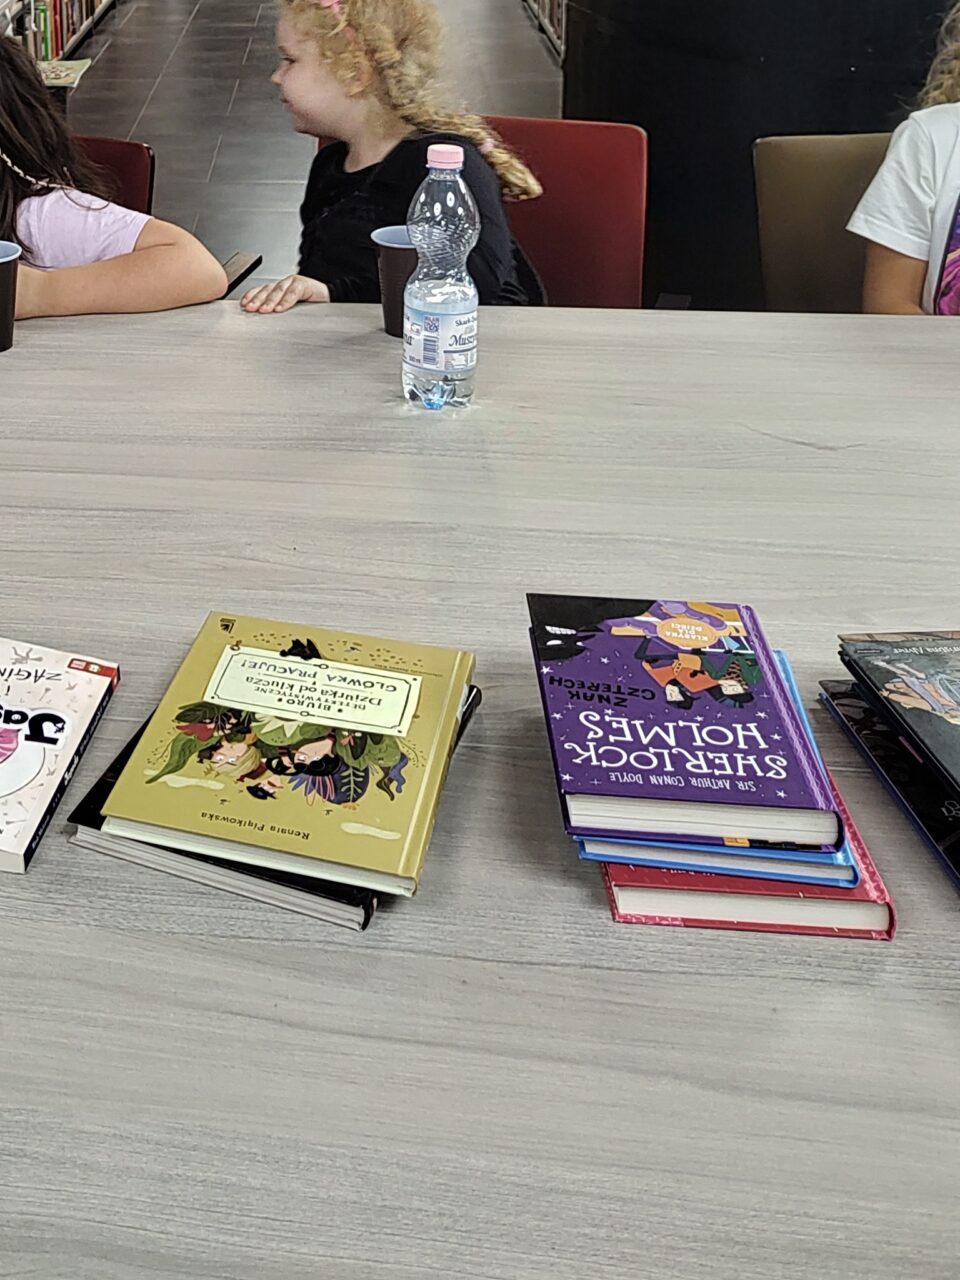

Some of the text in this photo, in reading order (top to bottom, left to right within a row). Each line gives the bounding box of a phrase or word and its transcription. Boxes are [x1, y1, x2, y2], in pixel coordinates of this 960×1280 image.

[663, 630, 709, 642] KLASYKA
[670, 622, 703, 632] DZIECI
[239, 659, 318, 681] PRACUJE!
[244, 675, 383, 707] Dziurka od klucza
[253, 685, 367, 711] DETEKTYWISTYCZNE
[548, 675, 656, 701] CZTERECH
[567, 690, 629, 708] ZNAK
[285, 697, 332, 712] BIURO
[578, 711, 768, 749] HOLMES
[563, 740, 788, 780] SHERLOCK
[609, 771, 757, 792] SIR ARTHUR CONAN DOYLE
[200, 810, 310, 841] Renata Piątkowska
